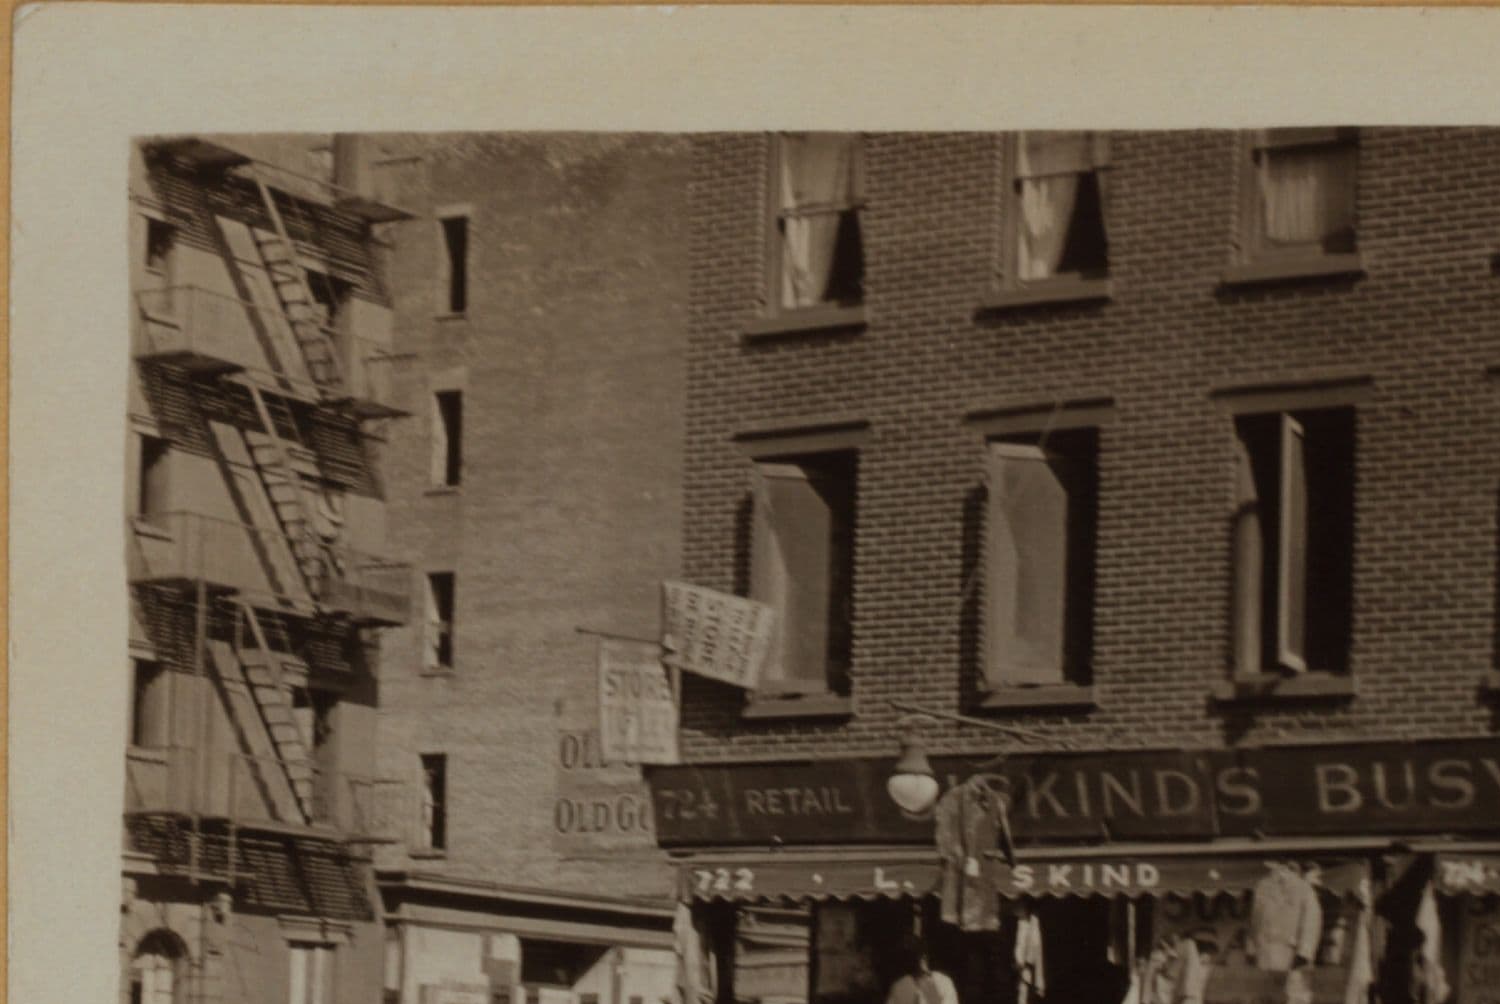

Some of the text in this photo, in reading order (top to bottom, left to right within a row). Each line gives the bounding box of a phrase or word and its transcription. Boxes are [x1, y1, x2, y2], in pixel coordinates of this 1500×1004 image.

[555, 797, 611, 833] OLD
[657, 787, 720, 820] 724
[743, 786, 854, 816] RETAIL
[695, 867, 754, 892] 722
